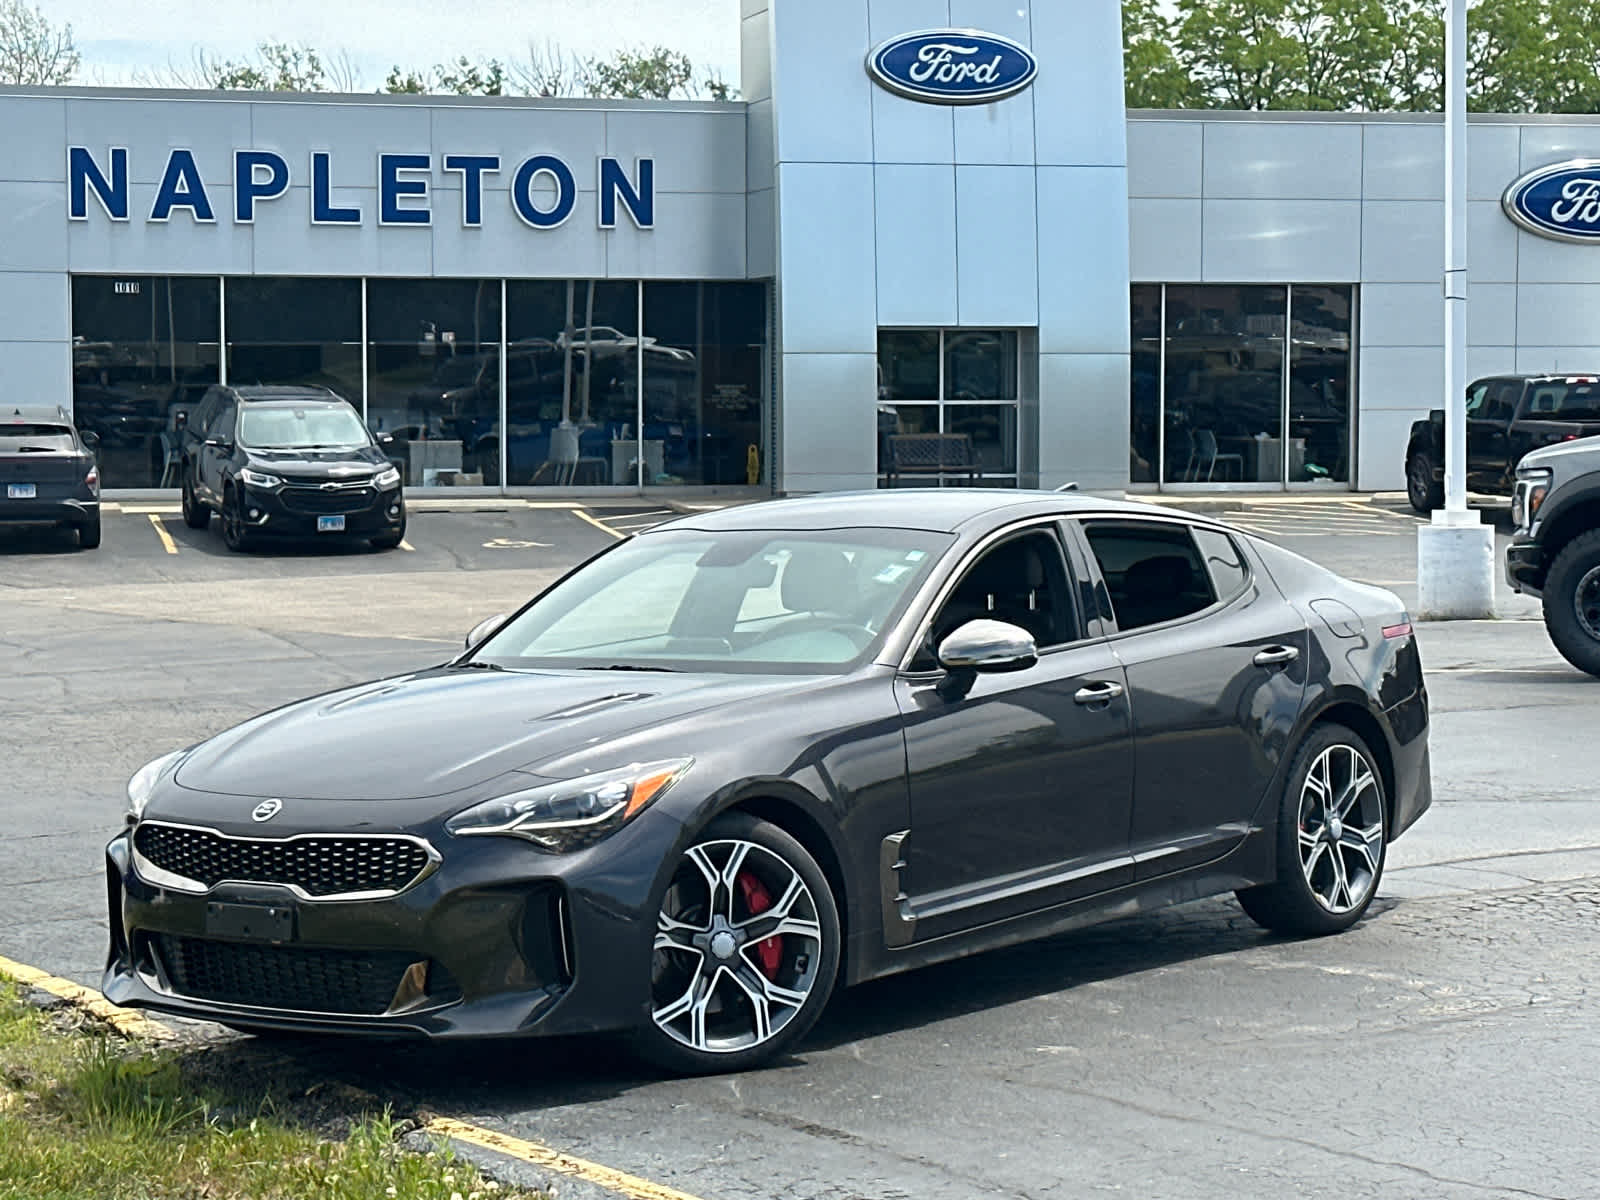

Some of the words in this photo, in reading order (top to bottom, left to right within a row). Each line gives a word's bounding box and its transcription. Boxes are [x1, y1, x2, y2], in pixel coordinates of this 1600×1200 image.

[909, 43, 1002, 83] Ford
[66, 145, 655, 230] NAPLETON
[1551, 178, 1600, 223] Fo
